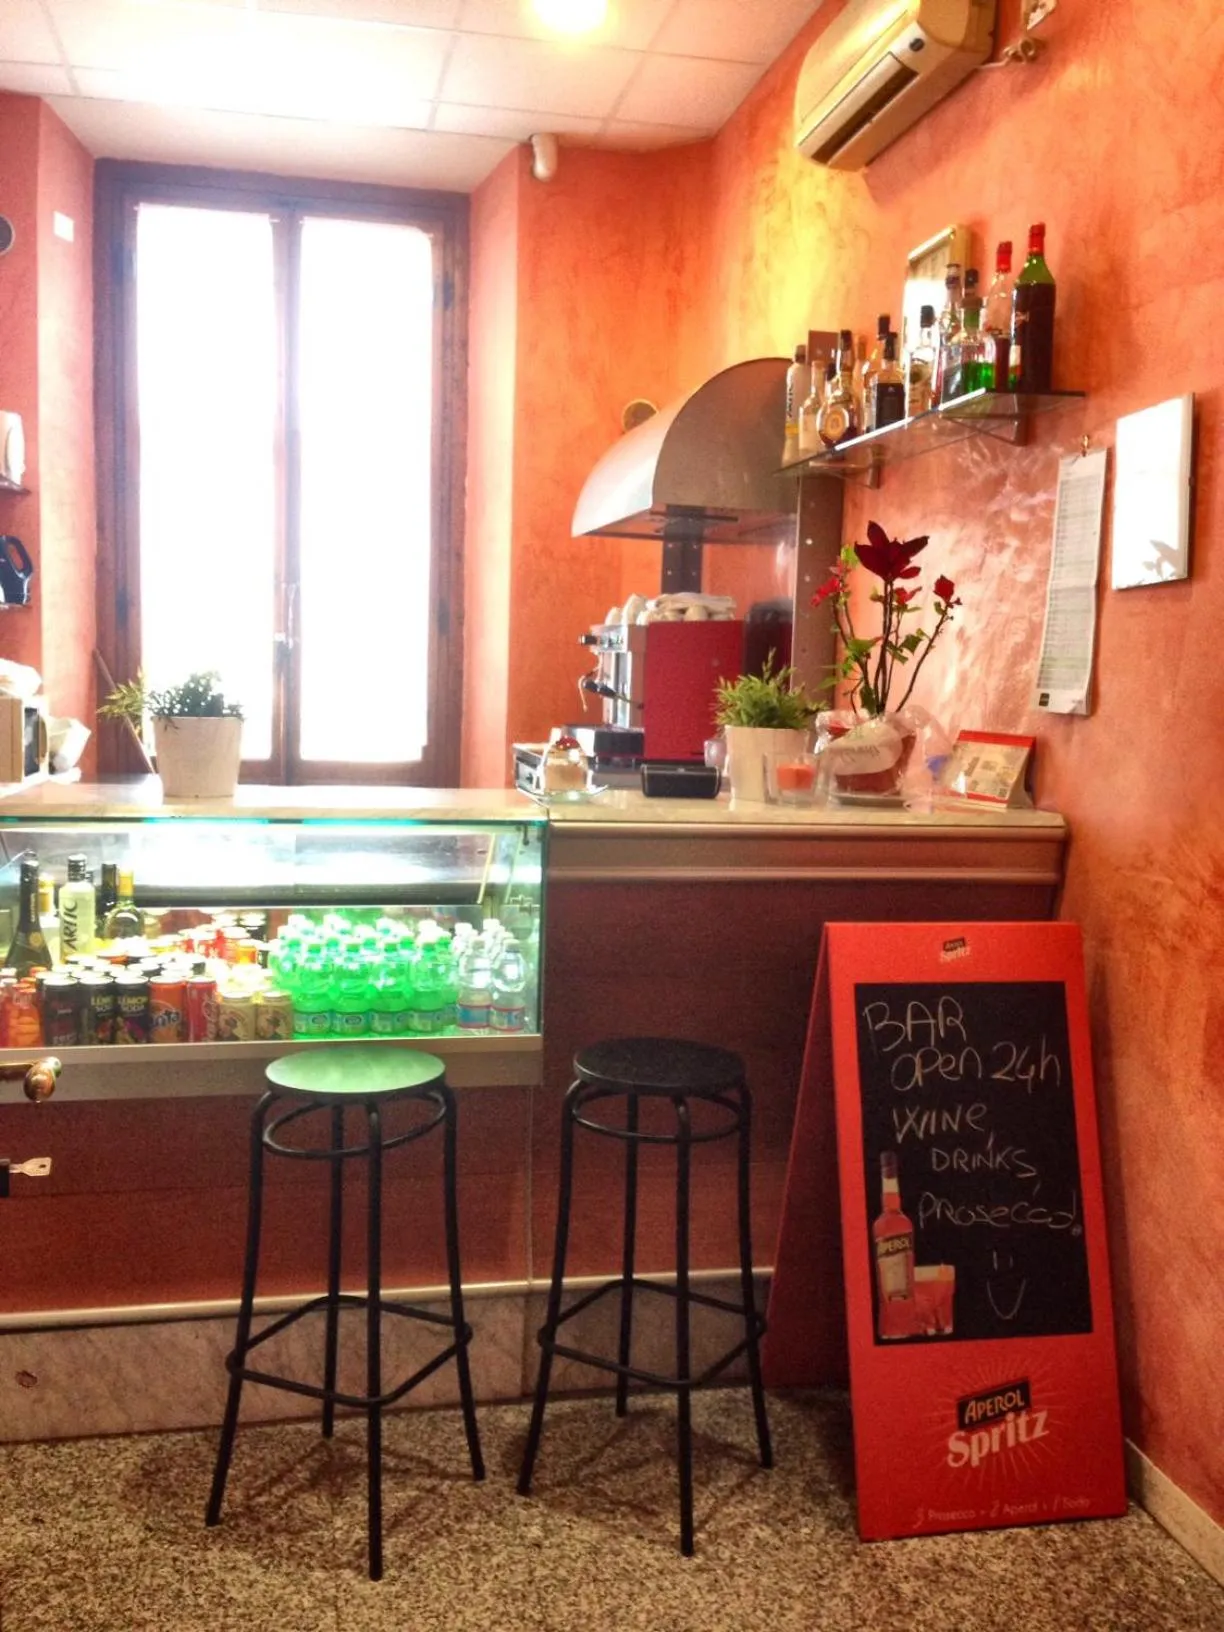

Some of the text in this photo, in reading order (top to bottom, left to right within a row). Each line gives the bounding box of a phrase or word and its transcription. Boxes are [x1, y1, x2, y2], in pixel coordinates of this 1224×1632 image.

[863, 996, 966, 1053] BAR
[991, 1033, 1061, 1095] 24h
[964, 1388, 1025, 1425] APEROL
[947, 1410, 1050, 1468] Spritz
